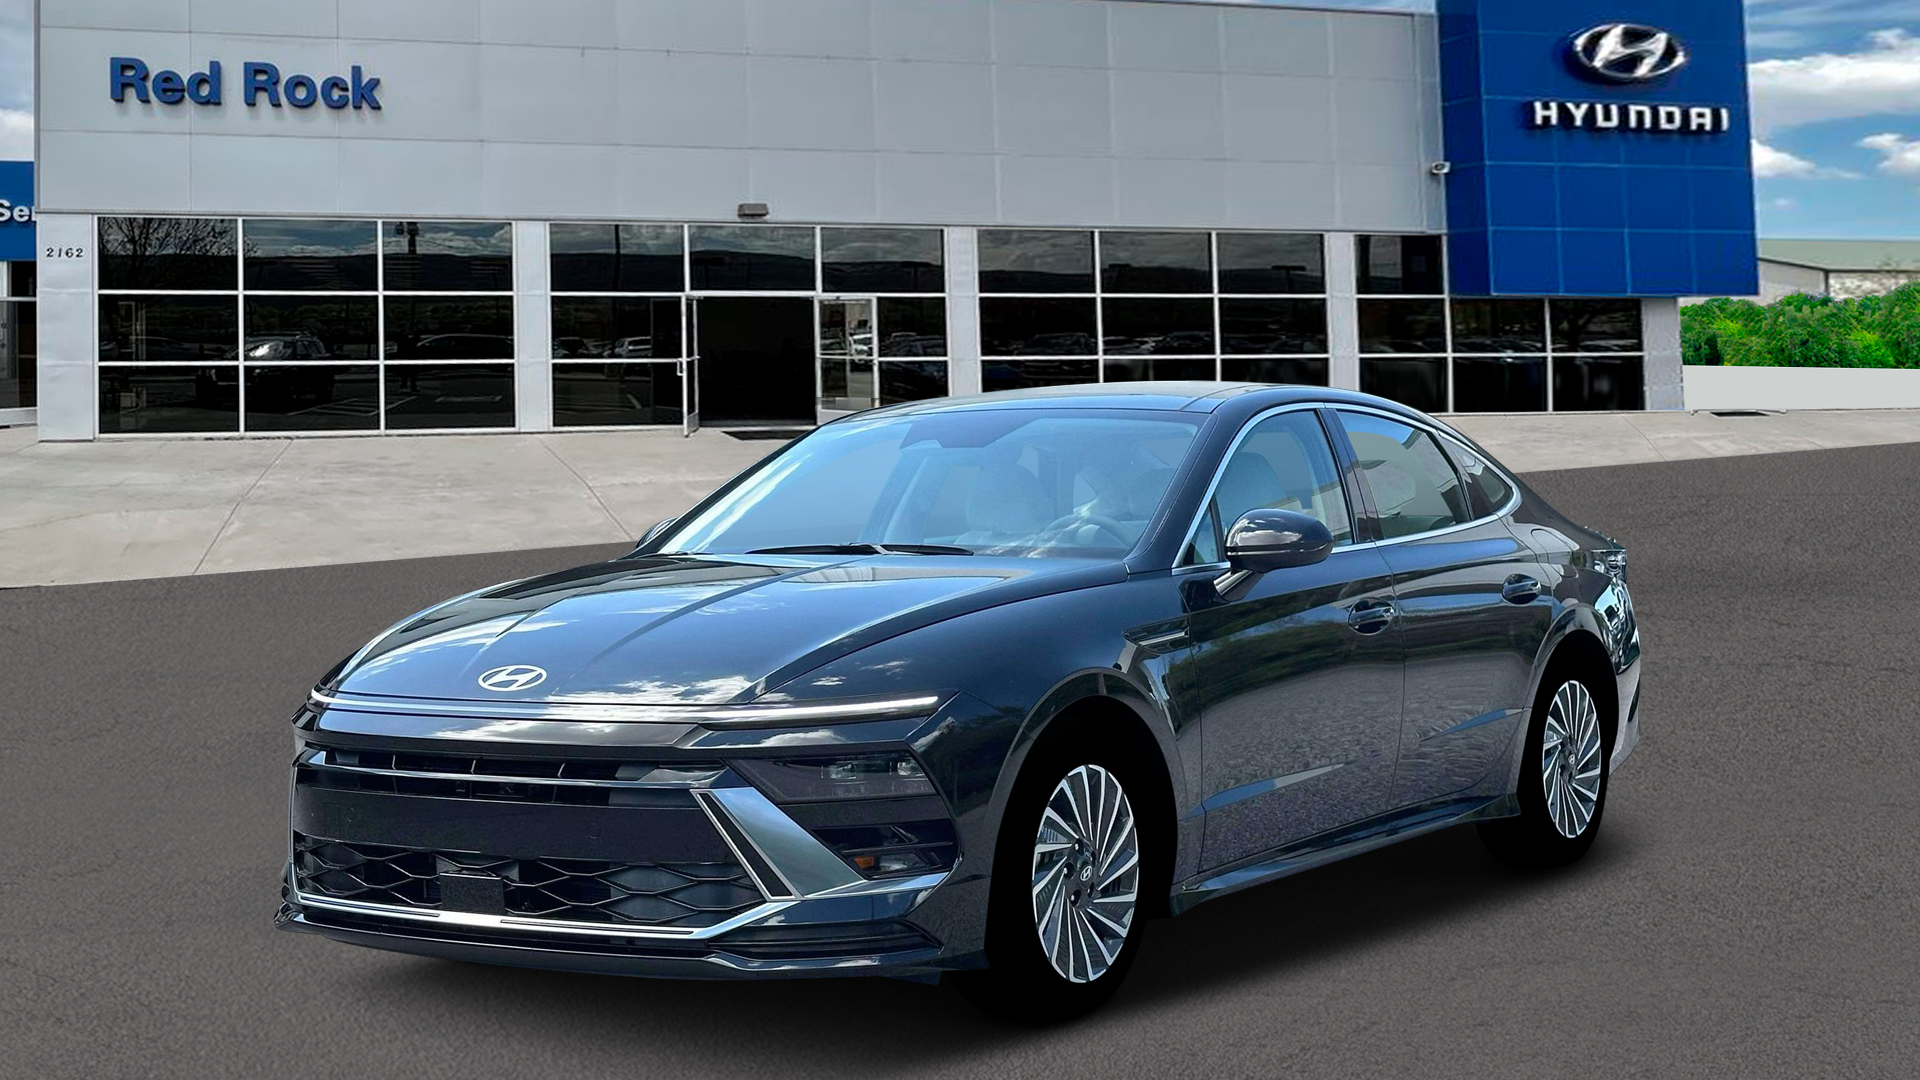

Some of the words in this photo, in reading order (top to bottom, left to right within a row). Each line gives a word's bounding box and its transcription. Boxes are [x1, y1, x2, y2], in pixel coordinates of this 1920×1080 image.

[110, 57, 222, 106] Red
[243, 61, 382, 111] Rock
[1533, 100, 1730, 132] HYUNDAI
[46, 247, 84, 258] 2162
